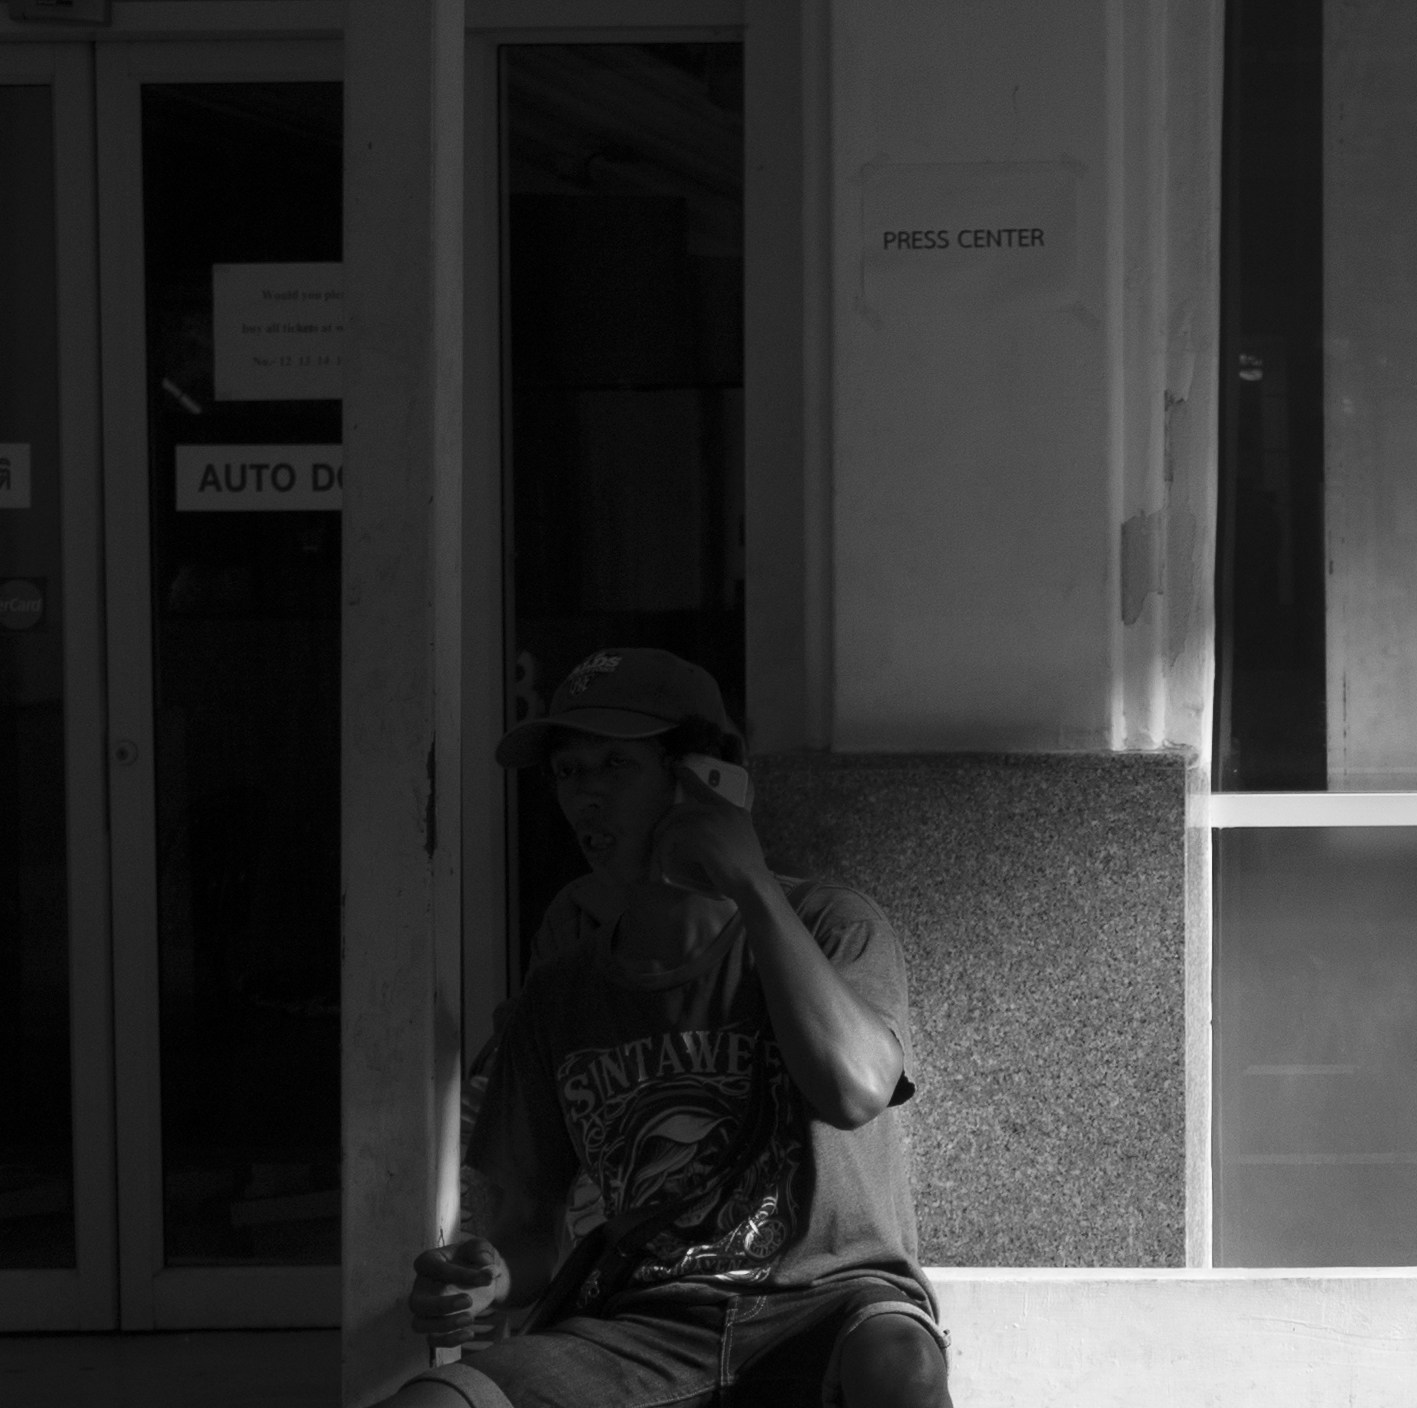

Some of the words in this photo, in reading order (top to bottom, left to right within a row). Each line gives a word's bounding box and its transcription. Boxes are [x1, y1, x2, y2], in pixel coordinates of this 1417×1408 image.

[883, 230, 949, 250] PRESS
[957, 228, 1045, 249] CENTER
[197, 461, 298, 494] AUTO
[310, 461, 343, 493] D
